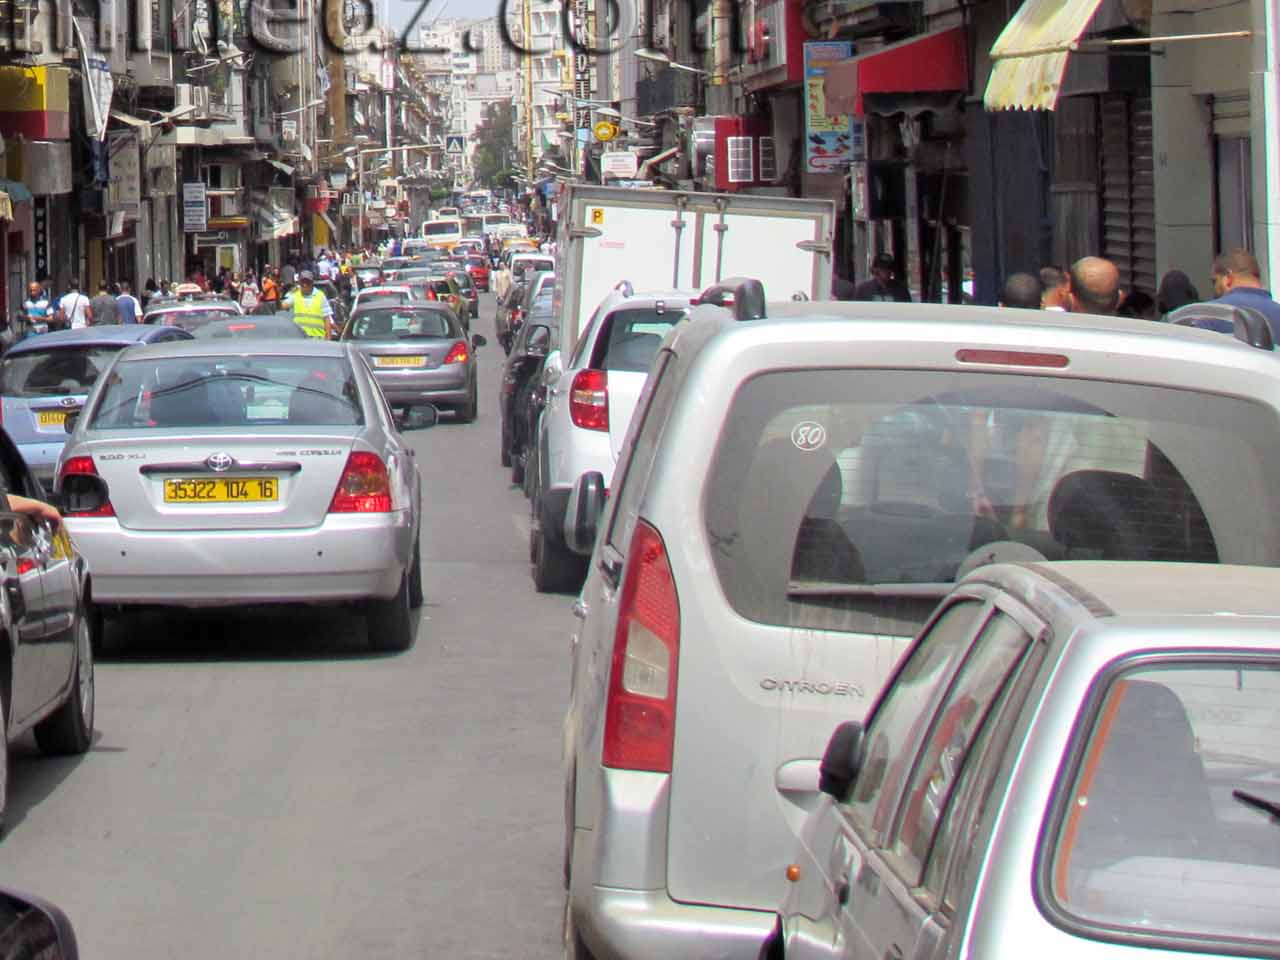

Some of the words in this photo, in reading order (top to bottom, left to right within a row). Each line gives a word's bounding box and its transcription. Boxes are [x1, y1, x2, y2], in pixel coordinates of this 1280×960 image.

[797, 425, 821, 445] 80
[223, 480, 249, 500] 104
[257, 479, 273, 499] 16
